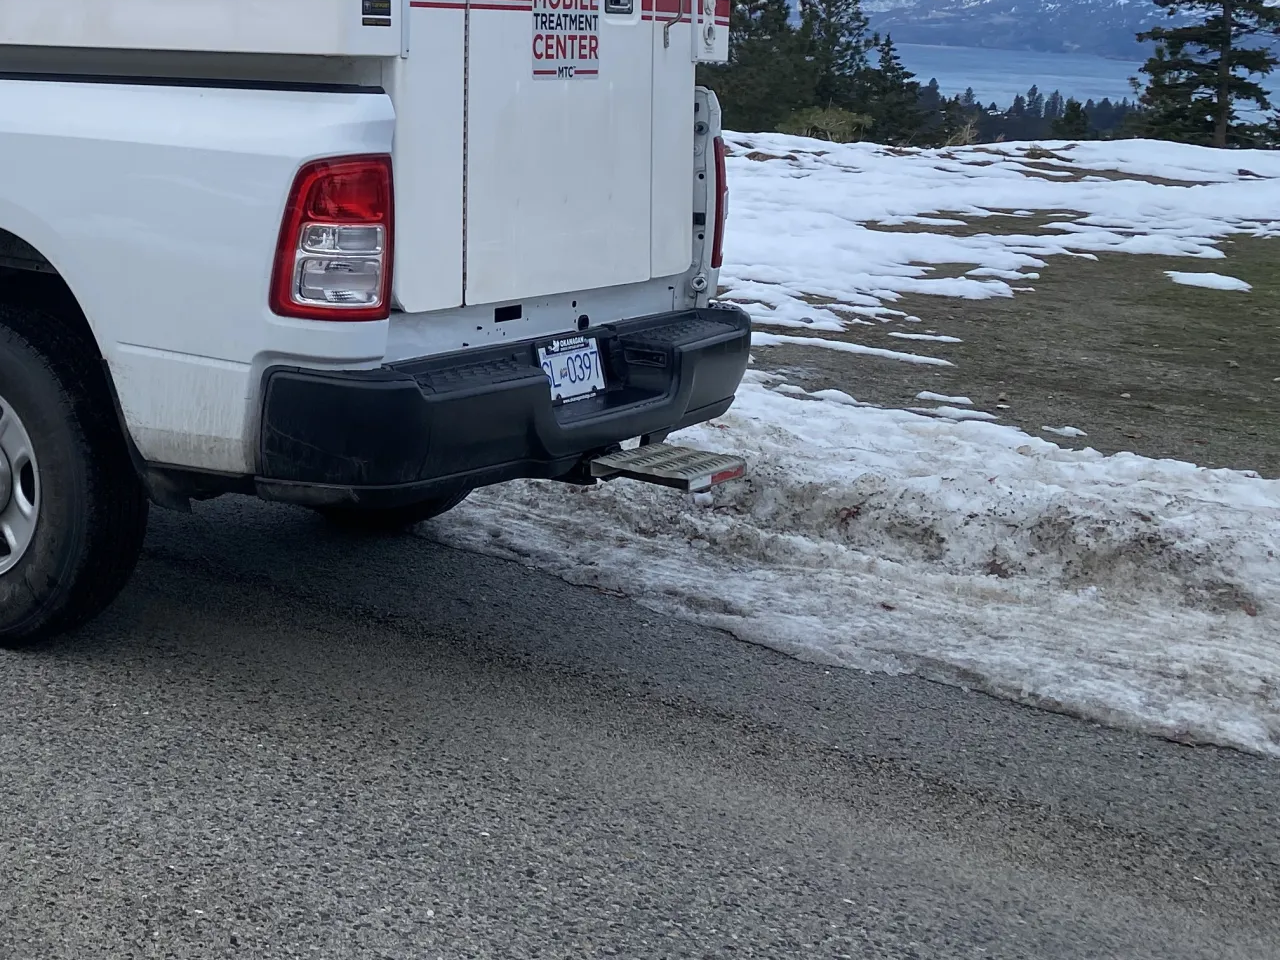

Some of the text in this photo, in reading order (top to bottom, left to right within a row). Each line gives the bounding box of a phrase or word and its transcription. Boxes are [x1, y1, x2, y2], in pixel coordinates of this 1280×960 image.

[533, 13, 599, 31] TREATMENT
[532, 33, 599, 60] CENTER
[566, 351, 599, 383] 0397
